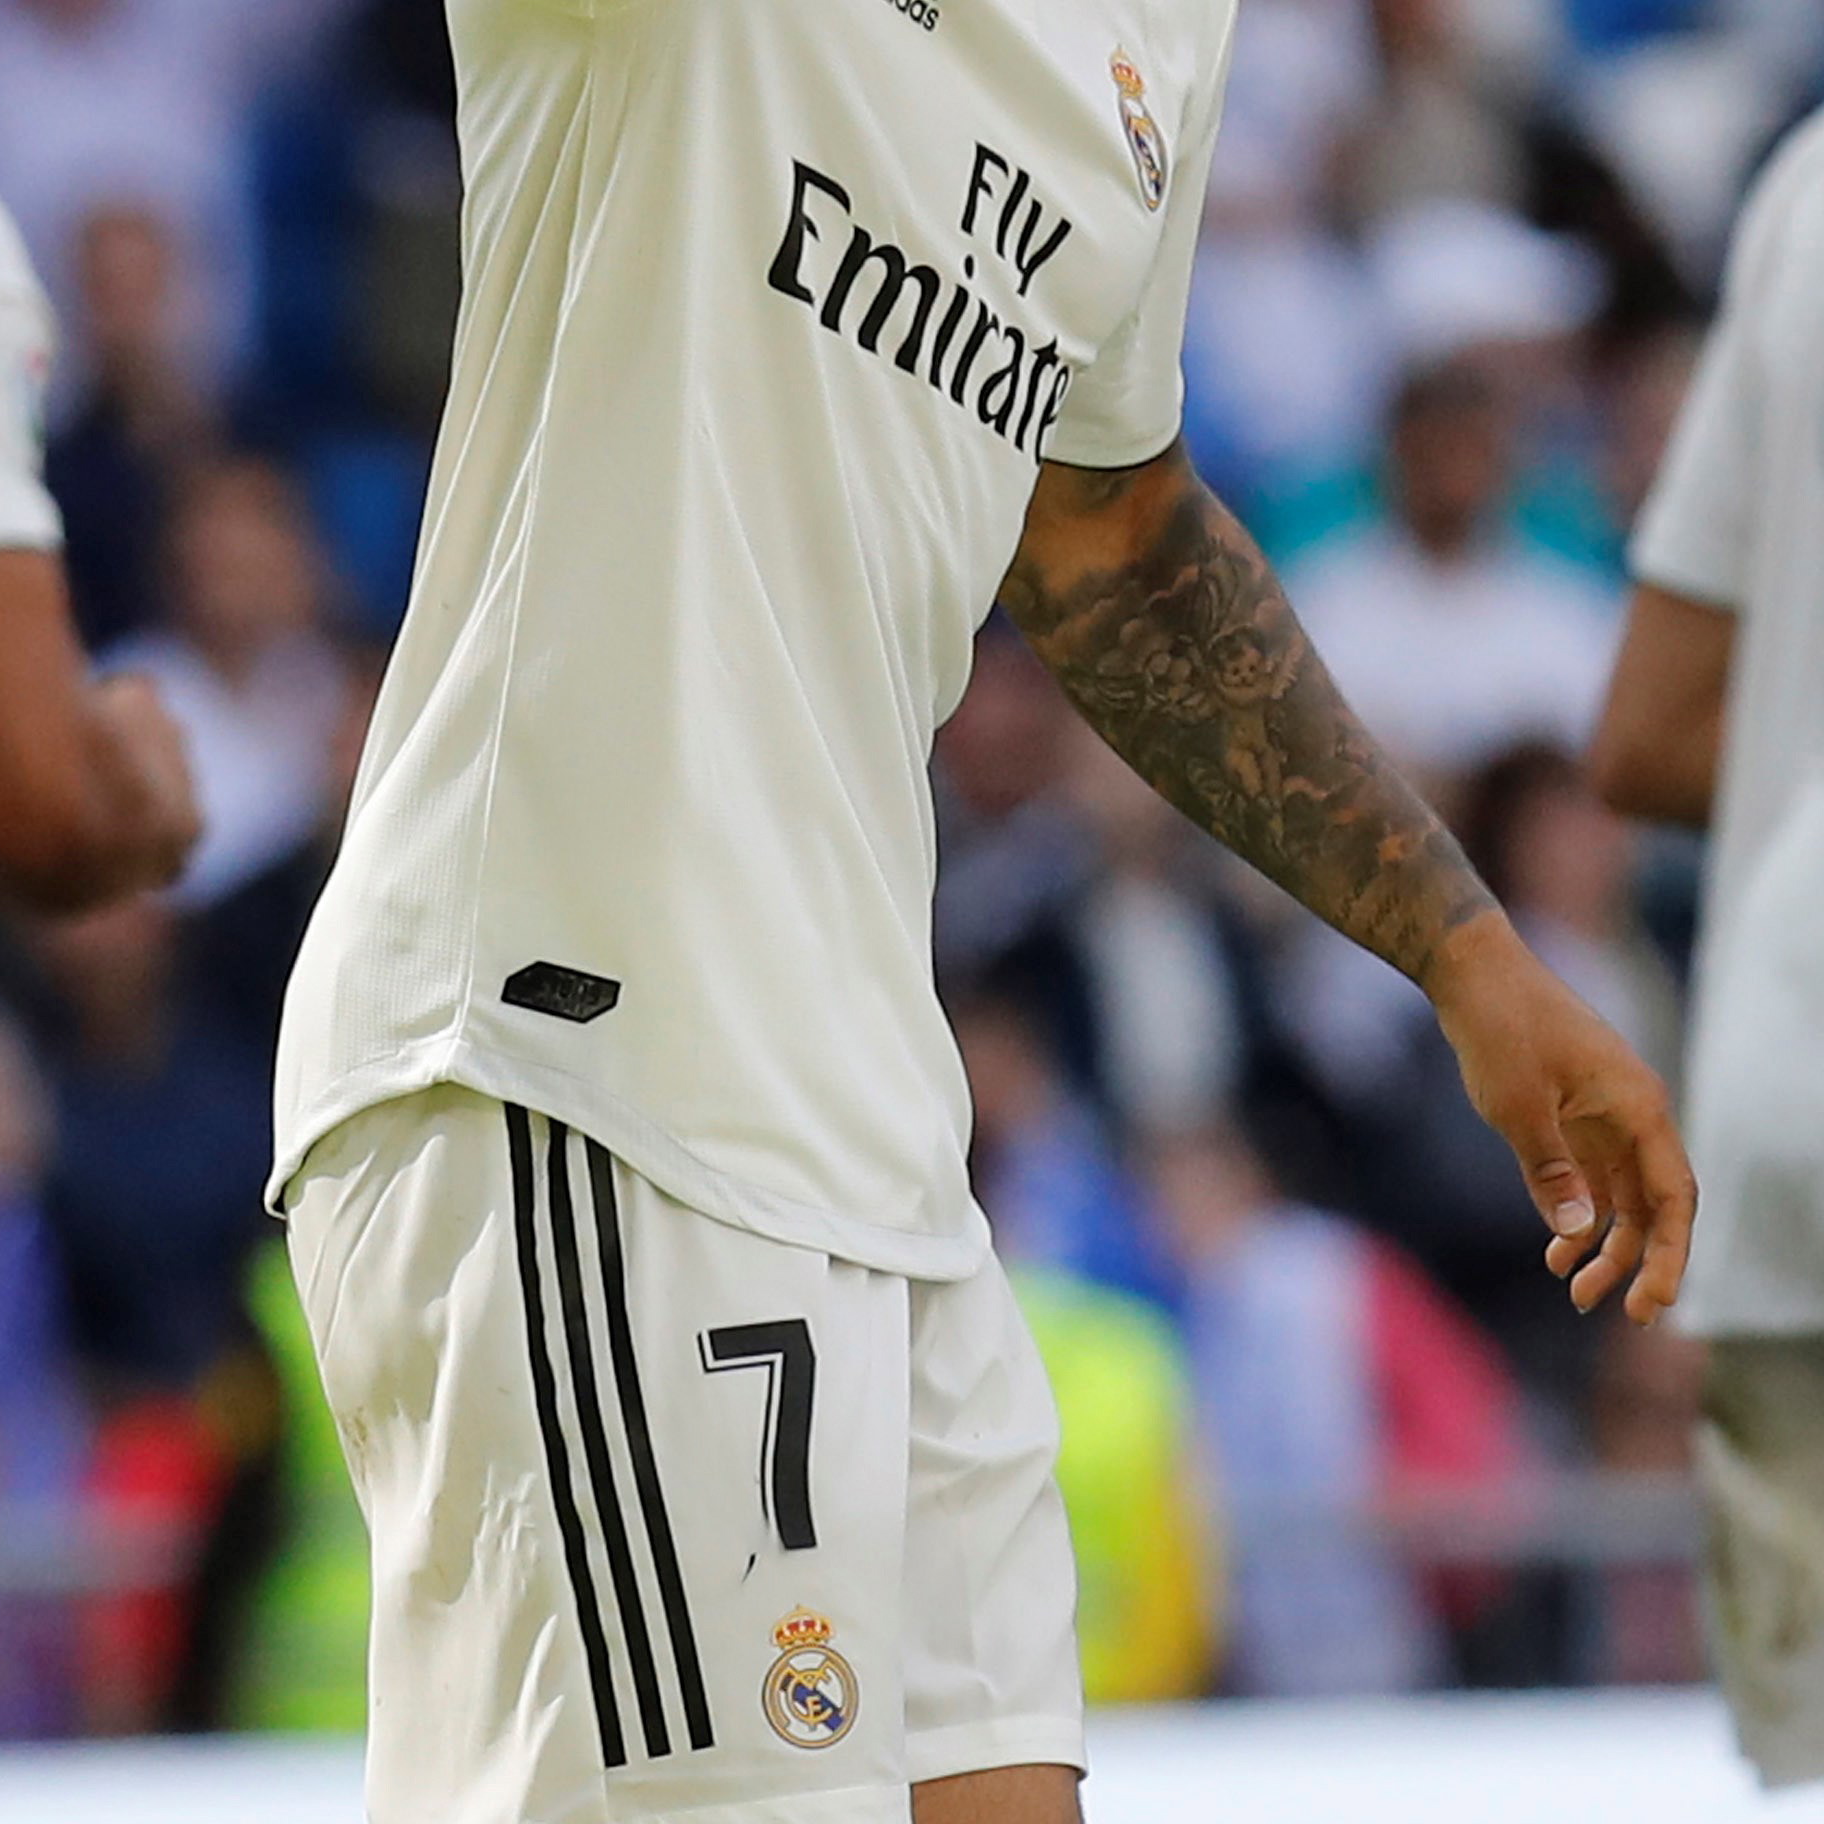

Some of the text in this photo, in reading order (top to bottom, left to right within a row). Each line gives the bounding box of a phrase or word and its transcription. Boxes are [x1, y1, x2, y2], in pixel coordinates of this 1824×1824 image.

[767, 157, 1070, 466] Emirate
[960, 140, 1072, 298] Fly
[696, 1318, 817, 1552] 7
